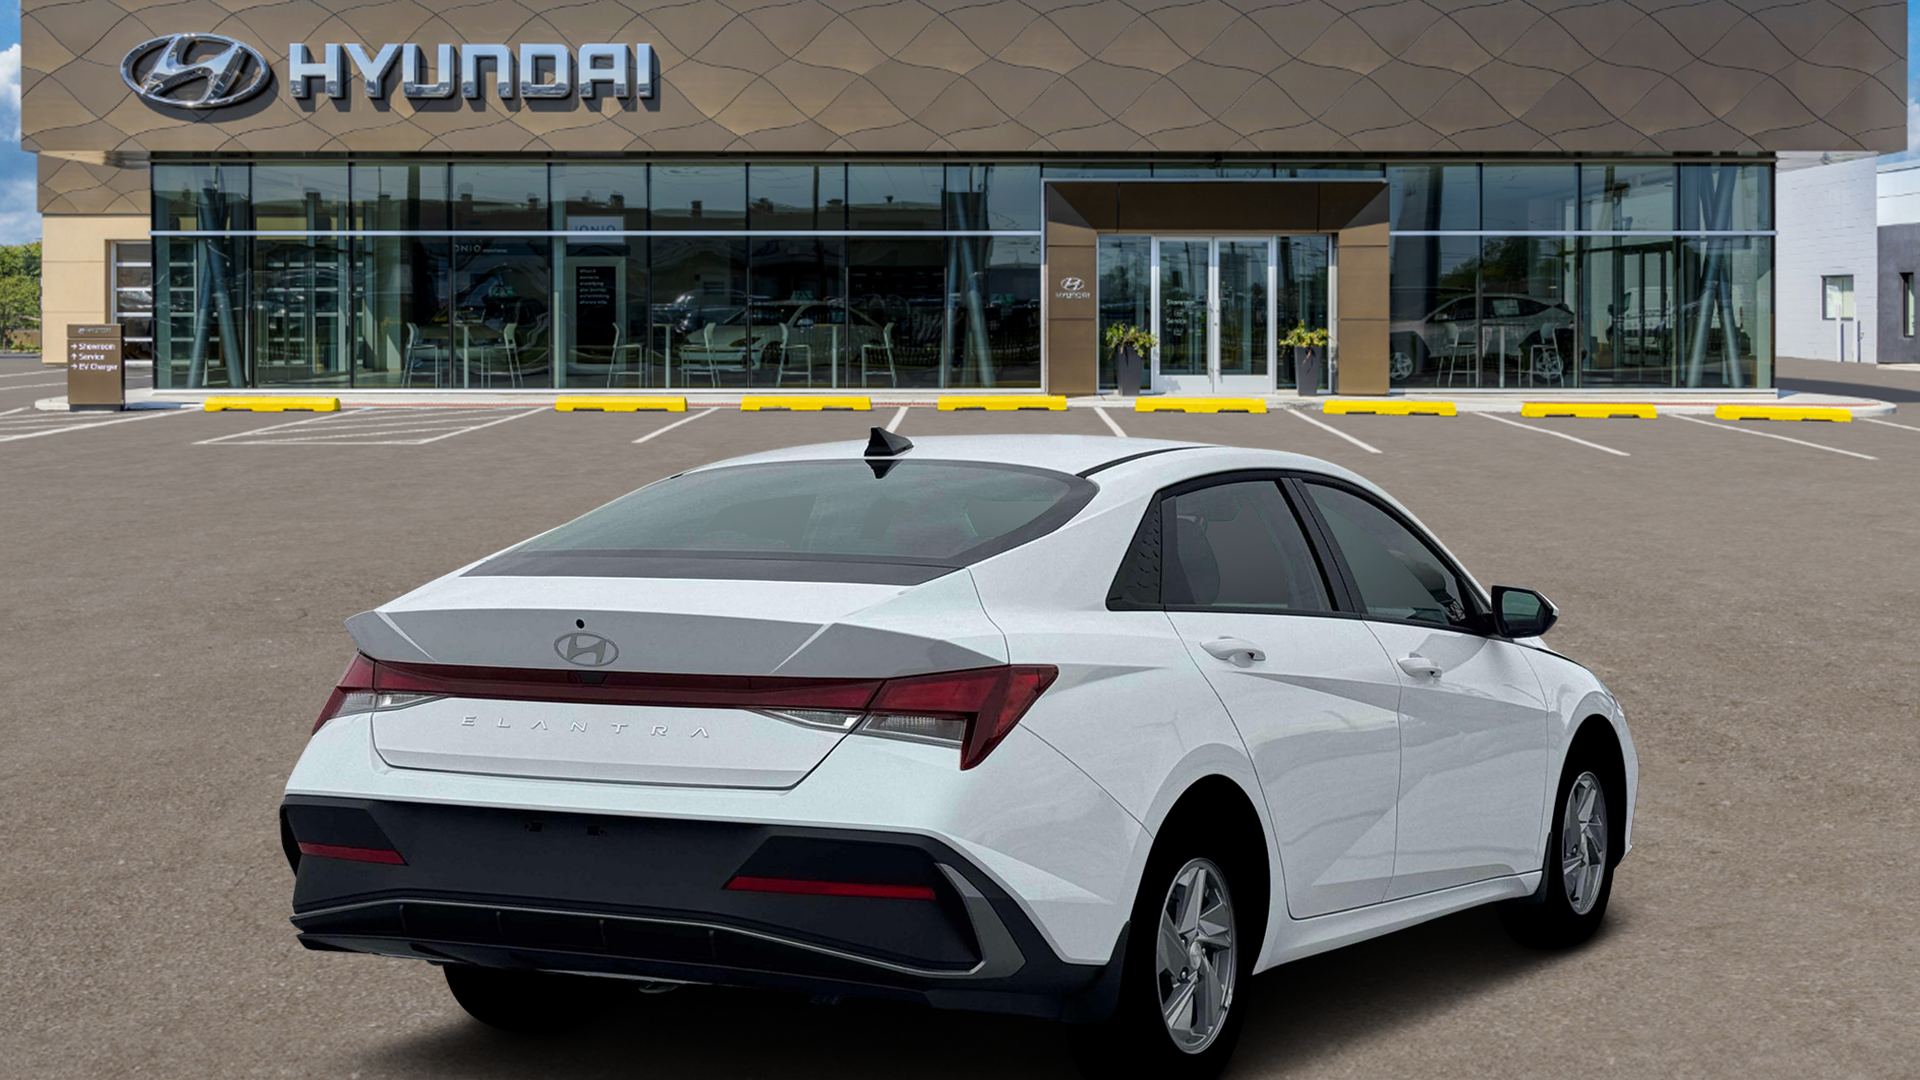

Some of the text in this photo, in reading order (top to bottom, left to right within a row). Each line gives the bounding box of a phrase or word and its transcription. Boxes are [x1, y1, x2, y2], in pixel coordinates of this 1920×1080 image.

[289, 43, 654, 99] HYUNDAI
[90, 363, 118, 372] Charger
[461, 715, 709, 738] ELANTRA
